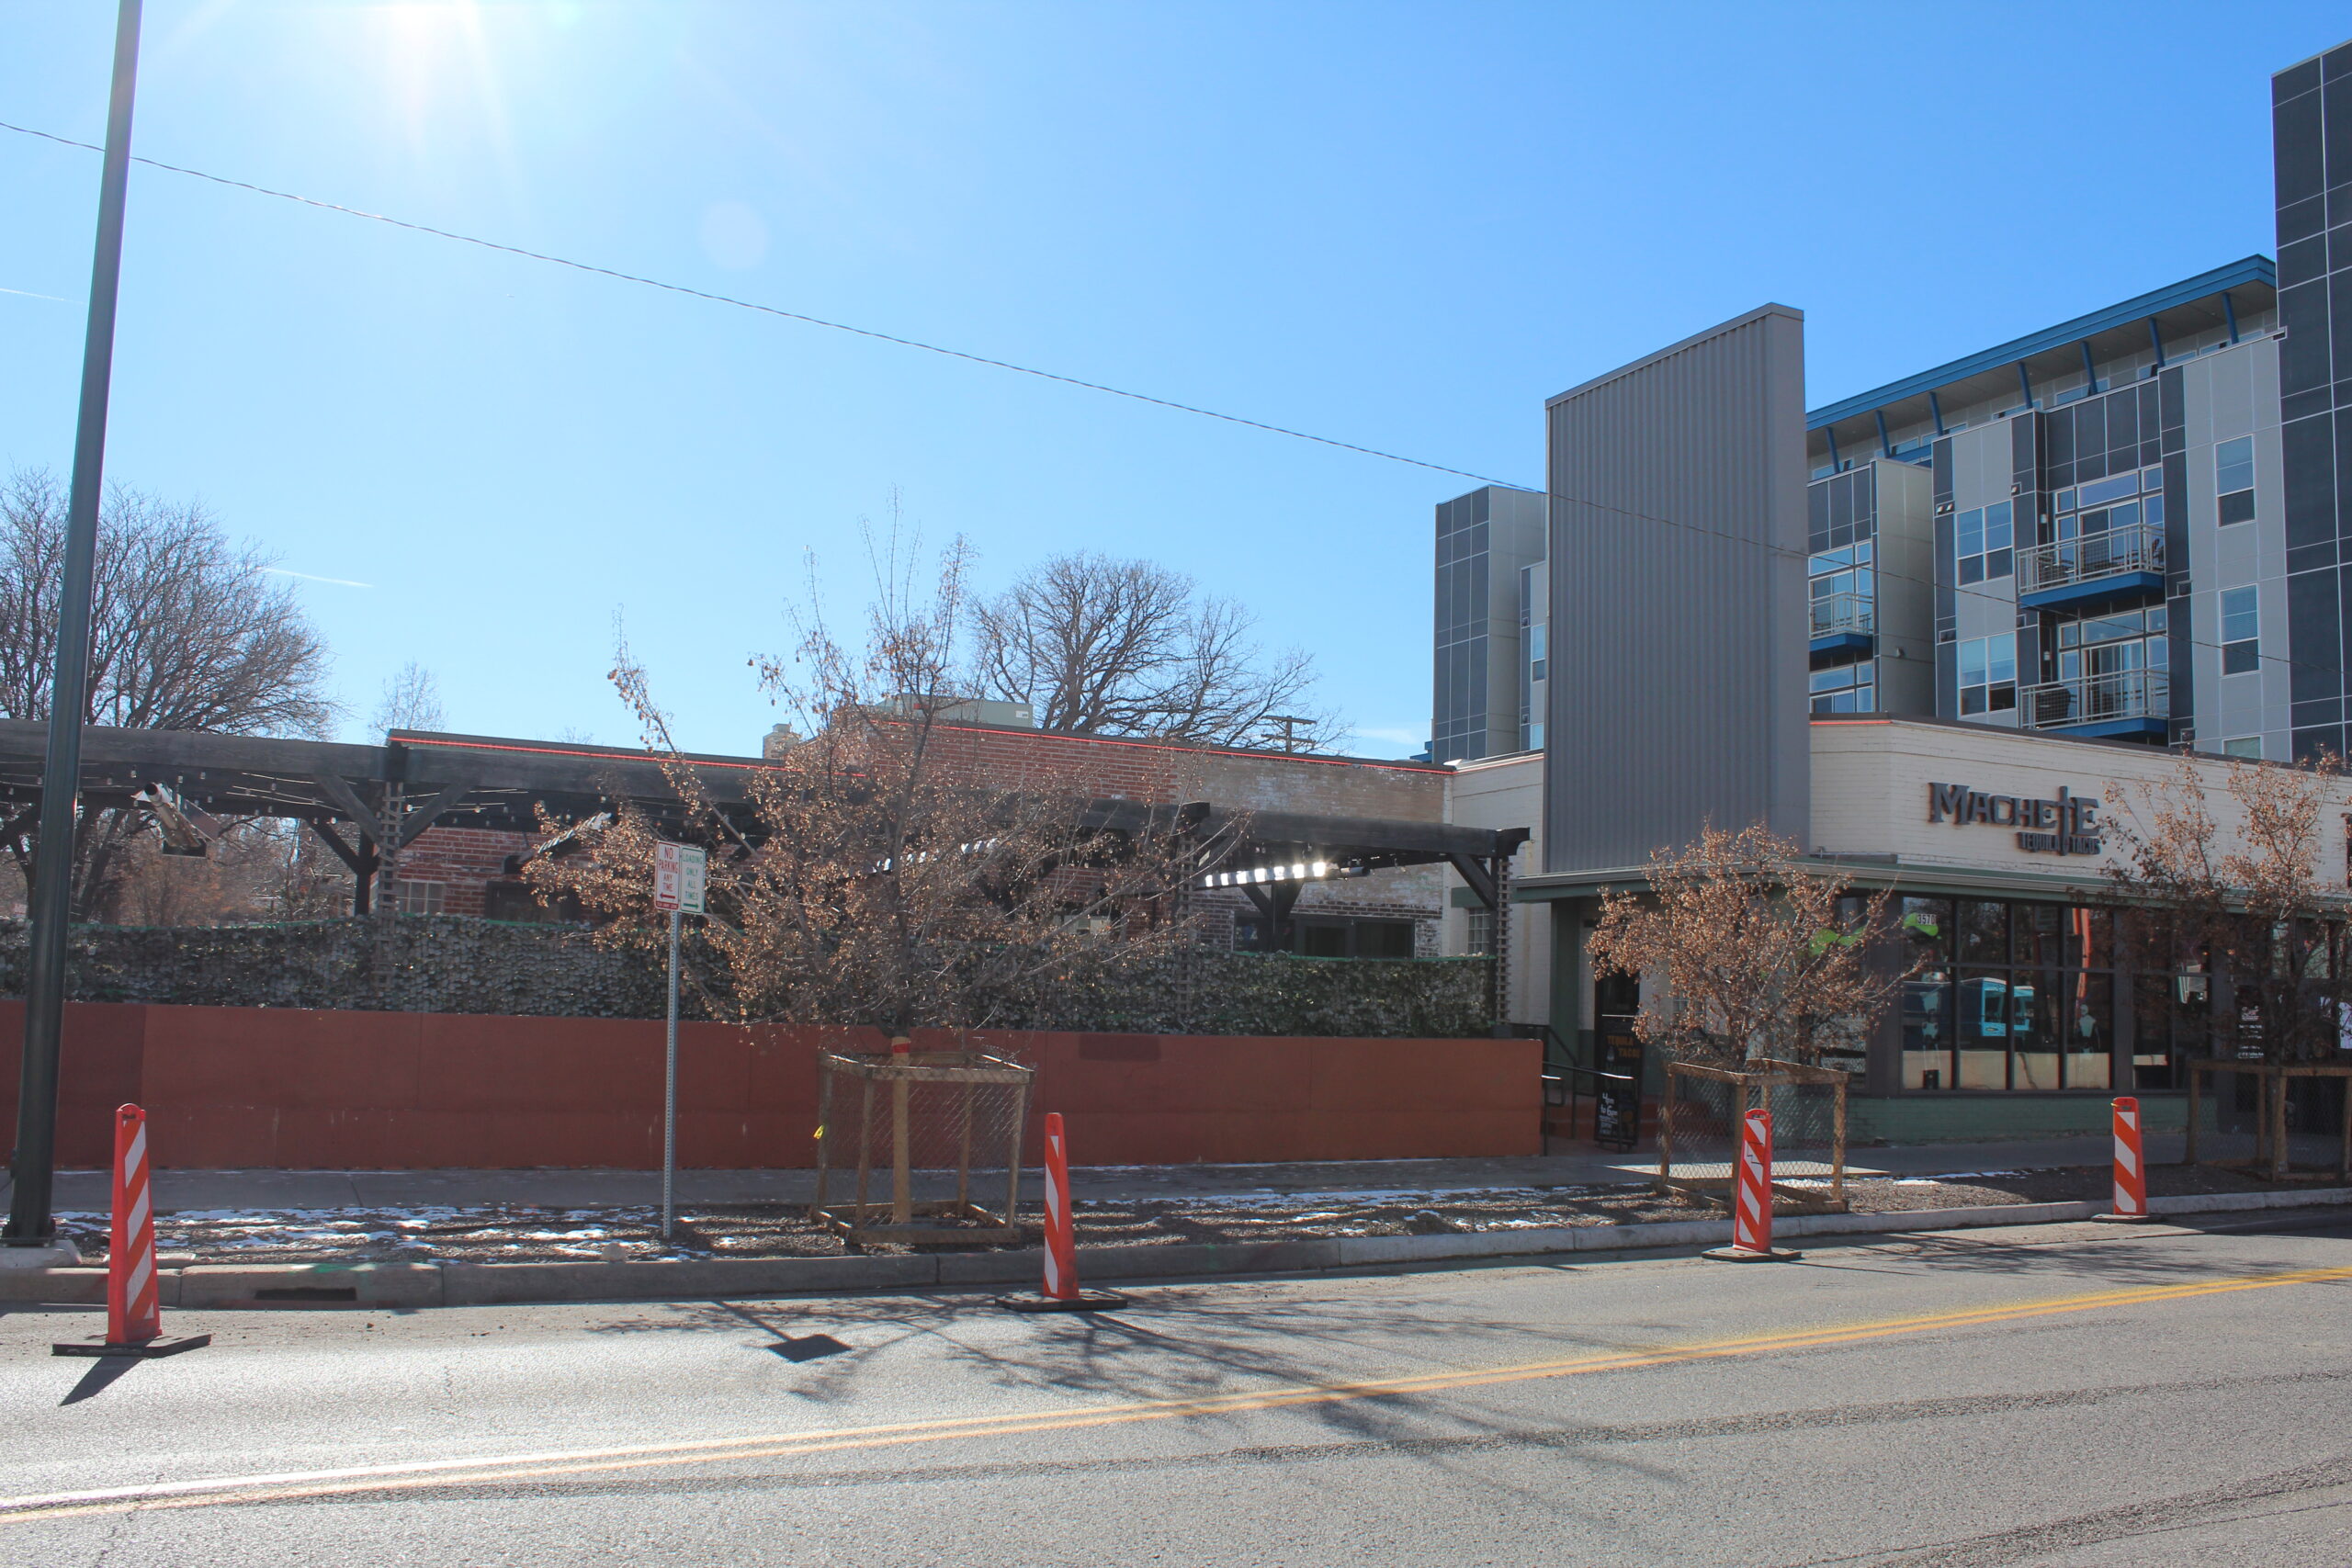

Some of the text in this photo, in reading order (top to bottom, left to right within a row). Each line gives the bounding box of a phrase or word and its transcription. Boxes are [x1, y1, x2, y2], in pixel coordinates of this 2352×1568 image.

[1928, 782, 2100, 855] MACHETE
[2017, 831, 2101, 855] TEQUILA TACOS
[664, 847, 673, 860] NO
[683, 852, 703, 864] LOADING
[659, 859, 678, 874] PARKING
[685, 867, 698, 877] ONLY
[663, 874, 673, 882] ANY
[687, 879, 696, 889] ALL
[662, 882, 673, 892] TIME
